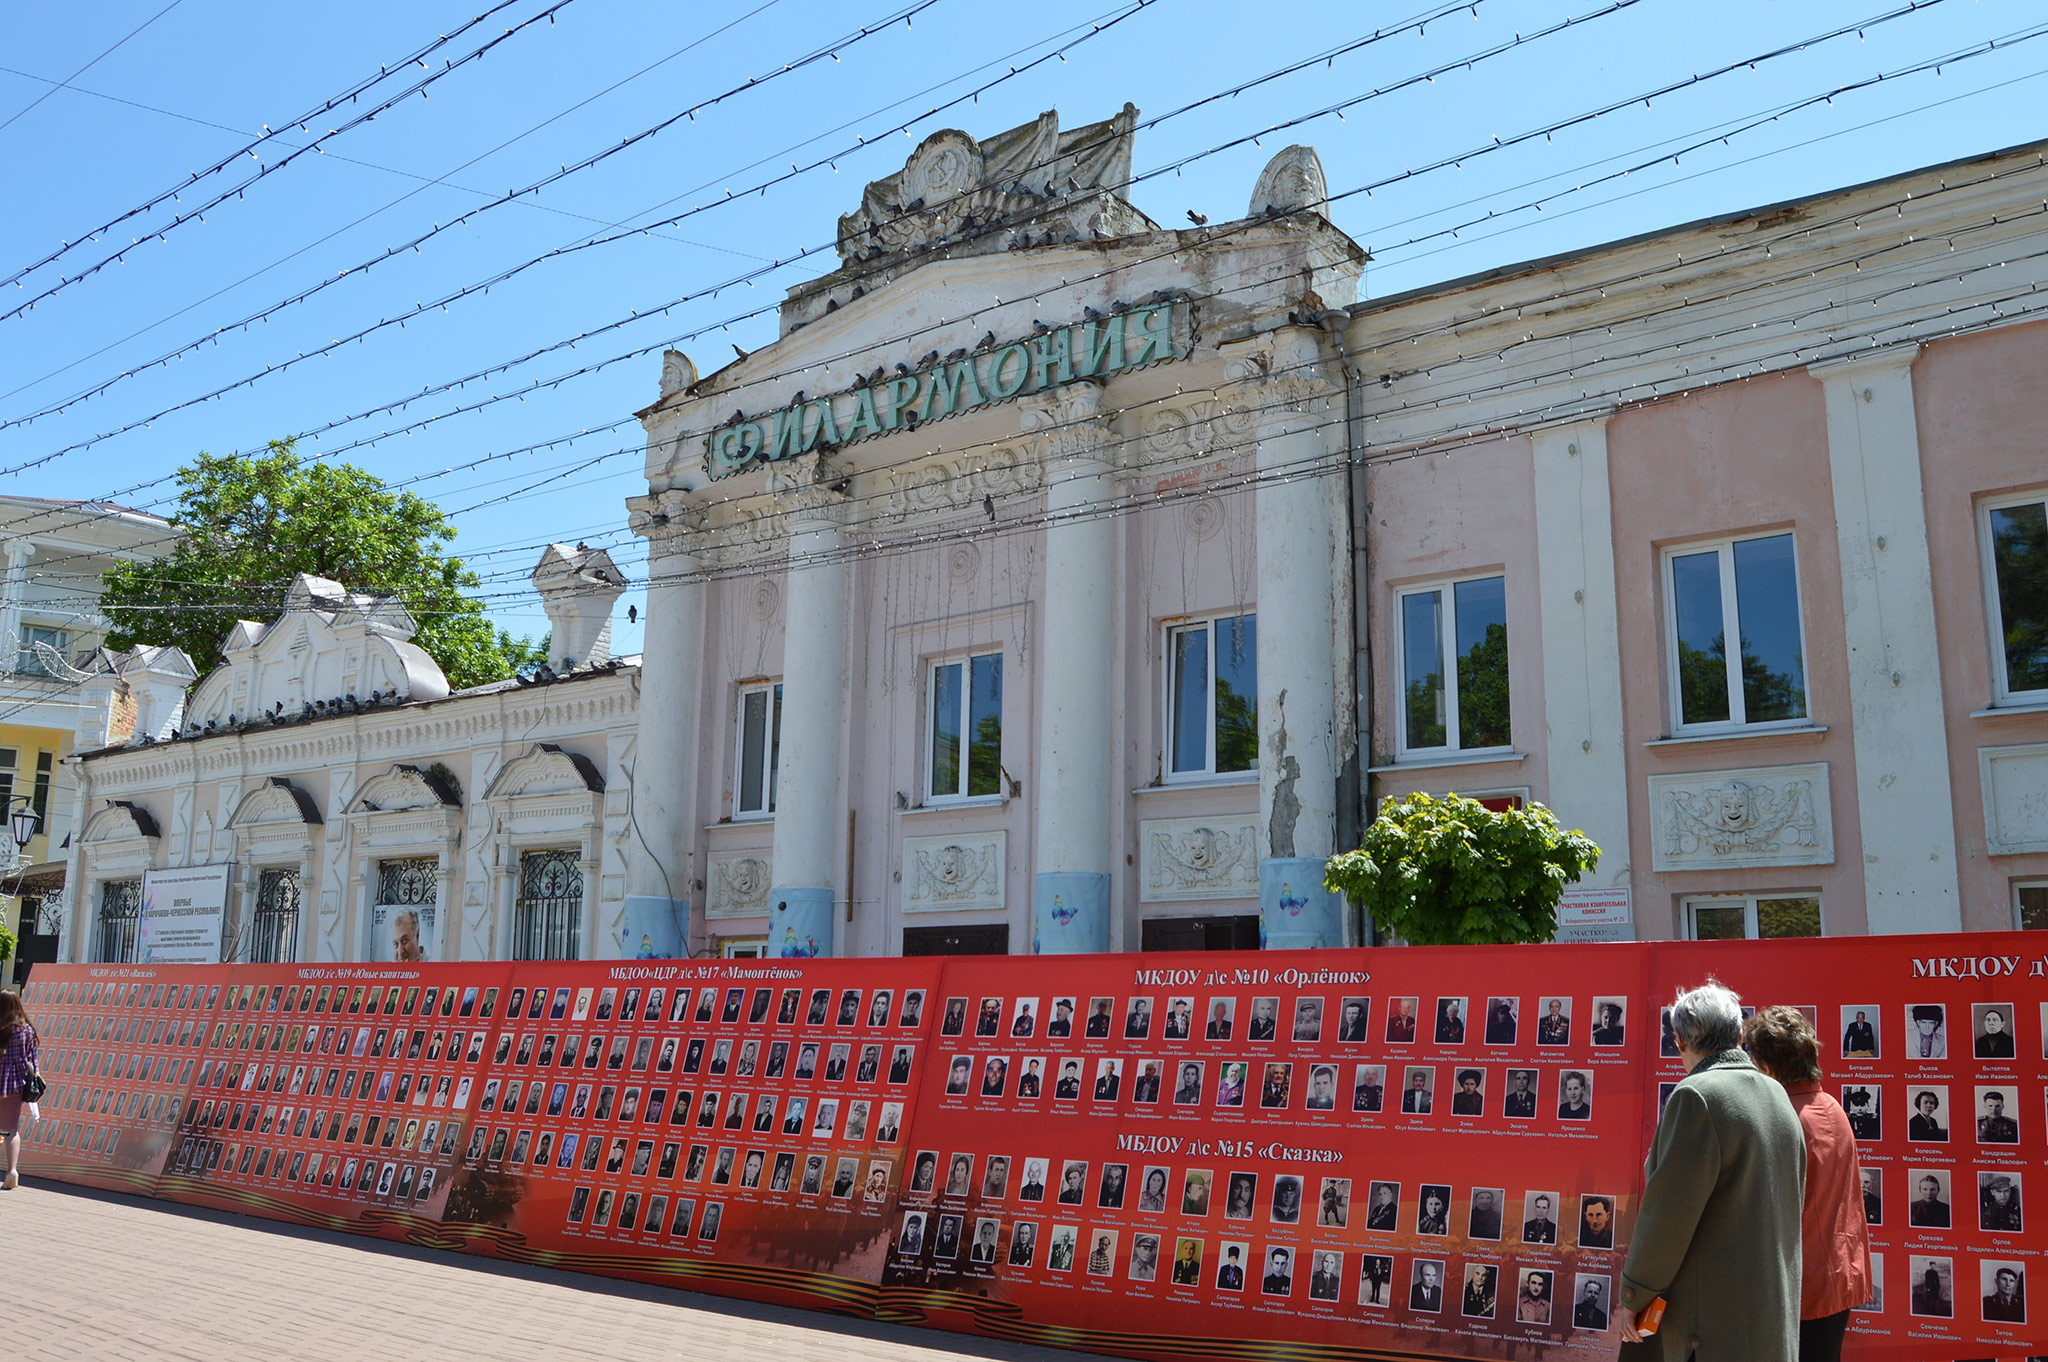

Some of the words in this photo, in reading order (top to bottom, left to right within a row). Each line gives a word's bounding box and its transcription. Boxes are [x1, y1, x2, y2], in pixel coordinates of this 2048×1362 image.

[715, 304, 1176, 470] ФИЛАРМОНИЯ
[1911, 956, 2021, 981] МКДОУ
[297, 968, 325, 980] МБДОО
[335, 968, 352, 979] №19
[352, 968, 379, 979] «Юные
[379, 970, 420, 979] капитаны»
[608, 967, 677, 981] МБДОО«ЦДР
[694, 967, 720, 979] №17
[720, 967, 803, 980] «Мамонтёнок»
[1134, 969, 1201, 988] МКДОУ
[1203, 970, 1227, 986] д\с
[1231, 968, 1269, 985] №10
[1274, 967, 1371, 989] «Орлёнок»
[1116, 1134, 1183, 1155] МБДОУ
[1186, 1137, 1210, 1157] д\с
[1214, 1139, 1254, 1158] №15
[1258, 1143, 1343, 1163] «Сказка»
[1918, 1234, 1943, 1242] Орехова
[1992, 1238, 2011, 1246] Орлов
[1904, 1241, 1923, 1249] Лидия
[1924, 1243, 1958, 1251] Георгиевна
[1966, 1245, 1994, 1253] Владилен
[1995, 1247, 2040, 1255] Александрович
[1851, 1326, 1891, 1335] Абдураманов
[1920, 1323, 1948, 1331] Семченко
[1907, 1330, 1932, 1339] Василий
[1933, 1332, 1961, 1341] Иванович
[1995, 1329, 2013, 1337] Титов
[1976, 1337, 2001, 1345] Николай
[2003, 1339, 2033, 1347] Иванович
